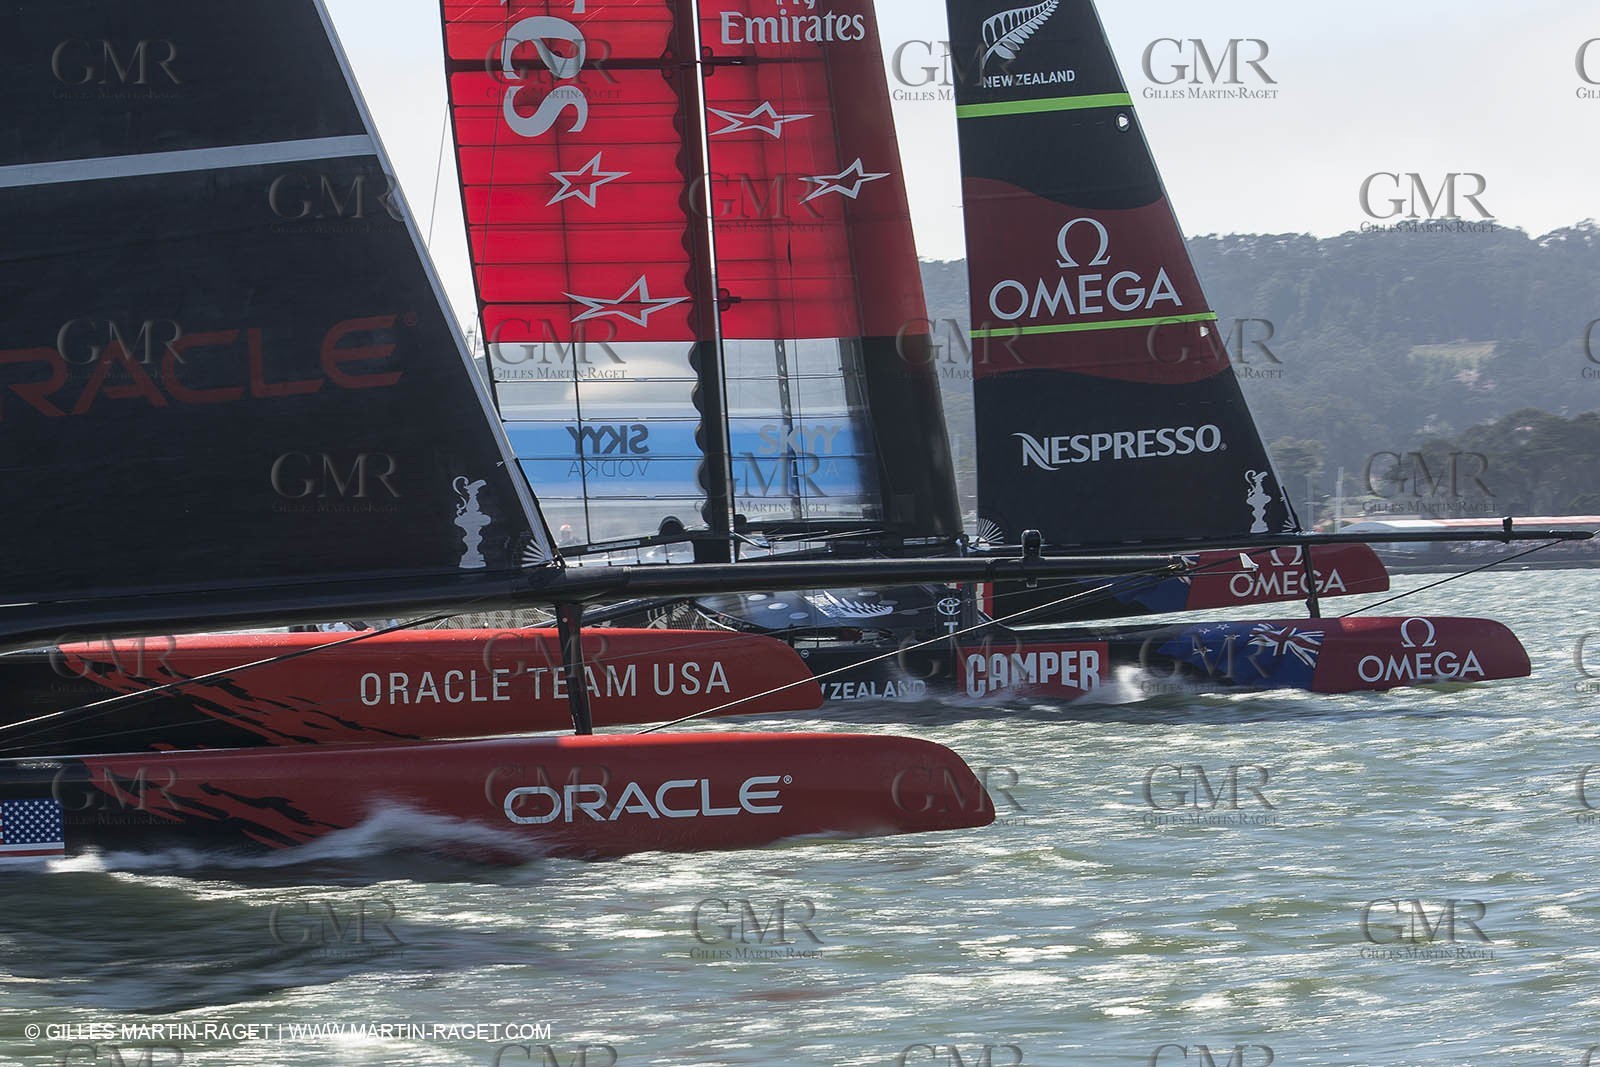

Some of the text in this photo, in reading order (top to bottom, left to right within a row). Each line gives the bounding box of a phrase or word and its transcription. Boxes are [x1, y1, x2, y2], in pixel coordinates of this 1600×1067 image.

[720, 9, 865, 44] Emirates
[500, 0, 588, 137] es
[983, 70, 1075, 88] NEW ZEALAND
[989, 266, 1183, 320] OMEGA
[0, 313, 402, 418] RACLE
[759, 424, 841, 454] SKYY
[1229, 568, 1347, 597] OMEGA
[360, 661, 730, 706] ORACLE TEAM USA
[966, 650, 1100, 698] CAMPER
[1358, 650, 1485, 682] OMEGA
[830, 680, 926, 700] ZEALAND
